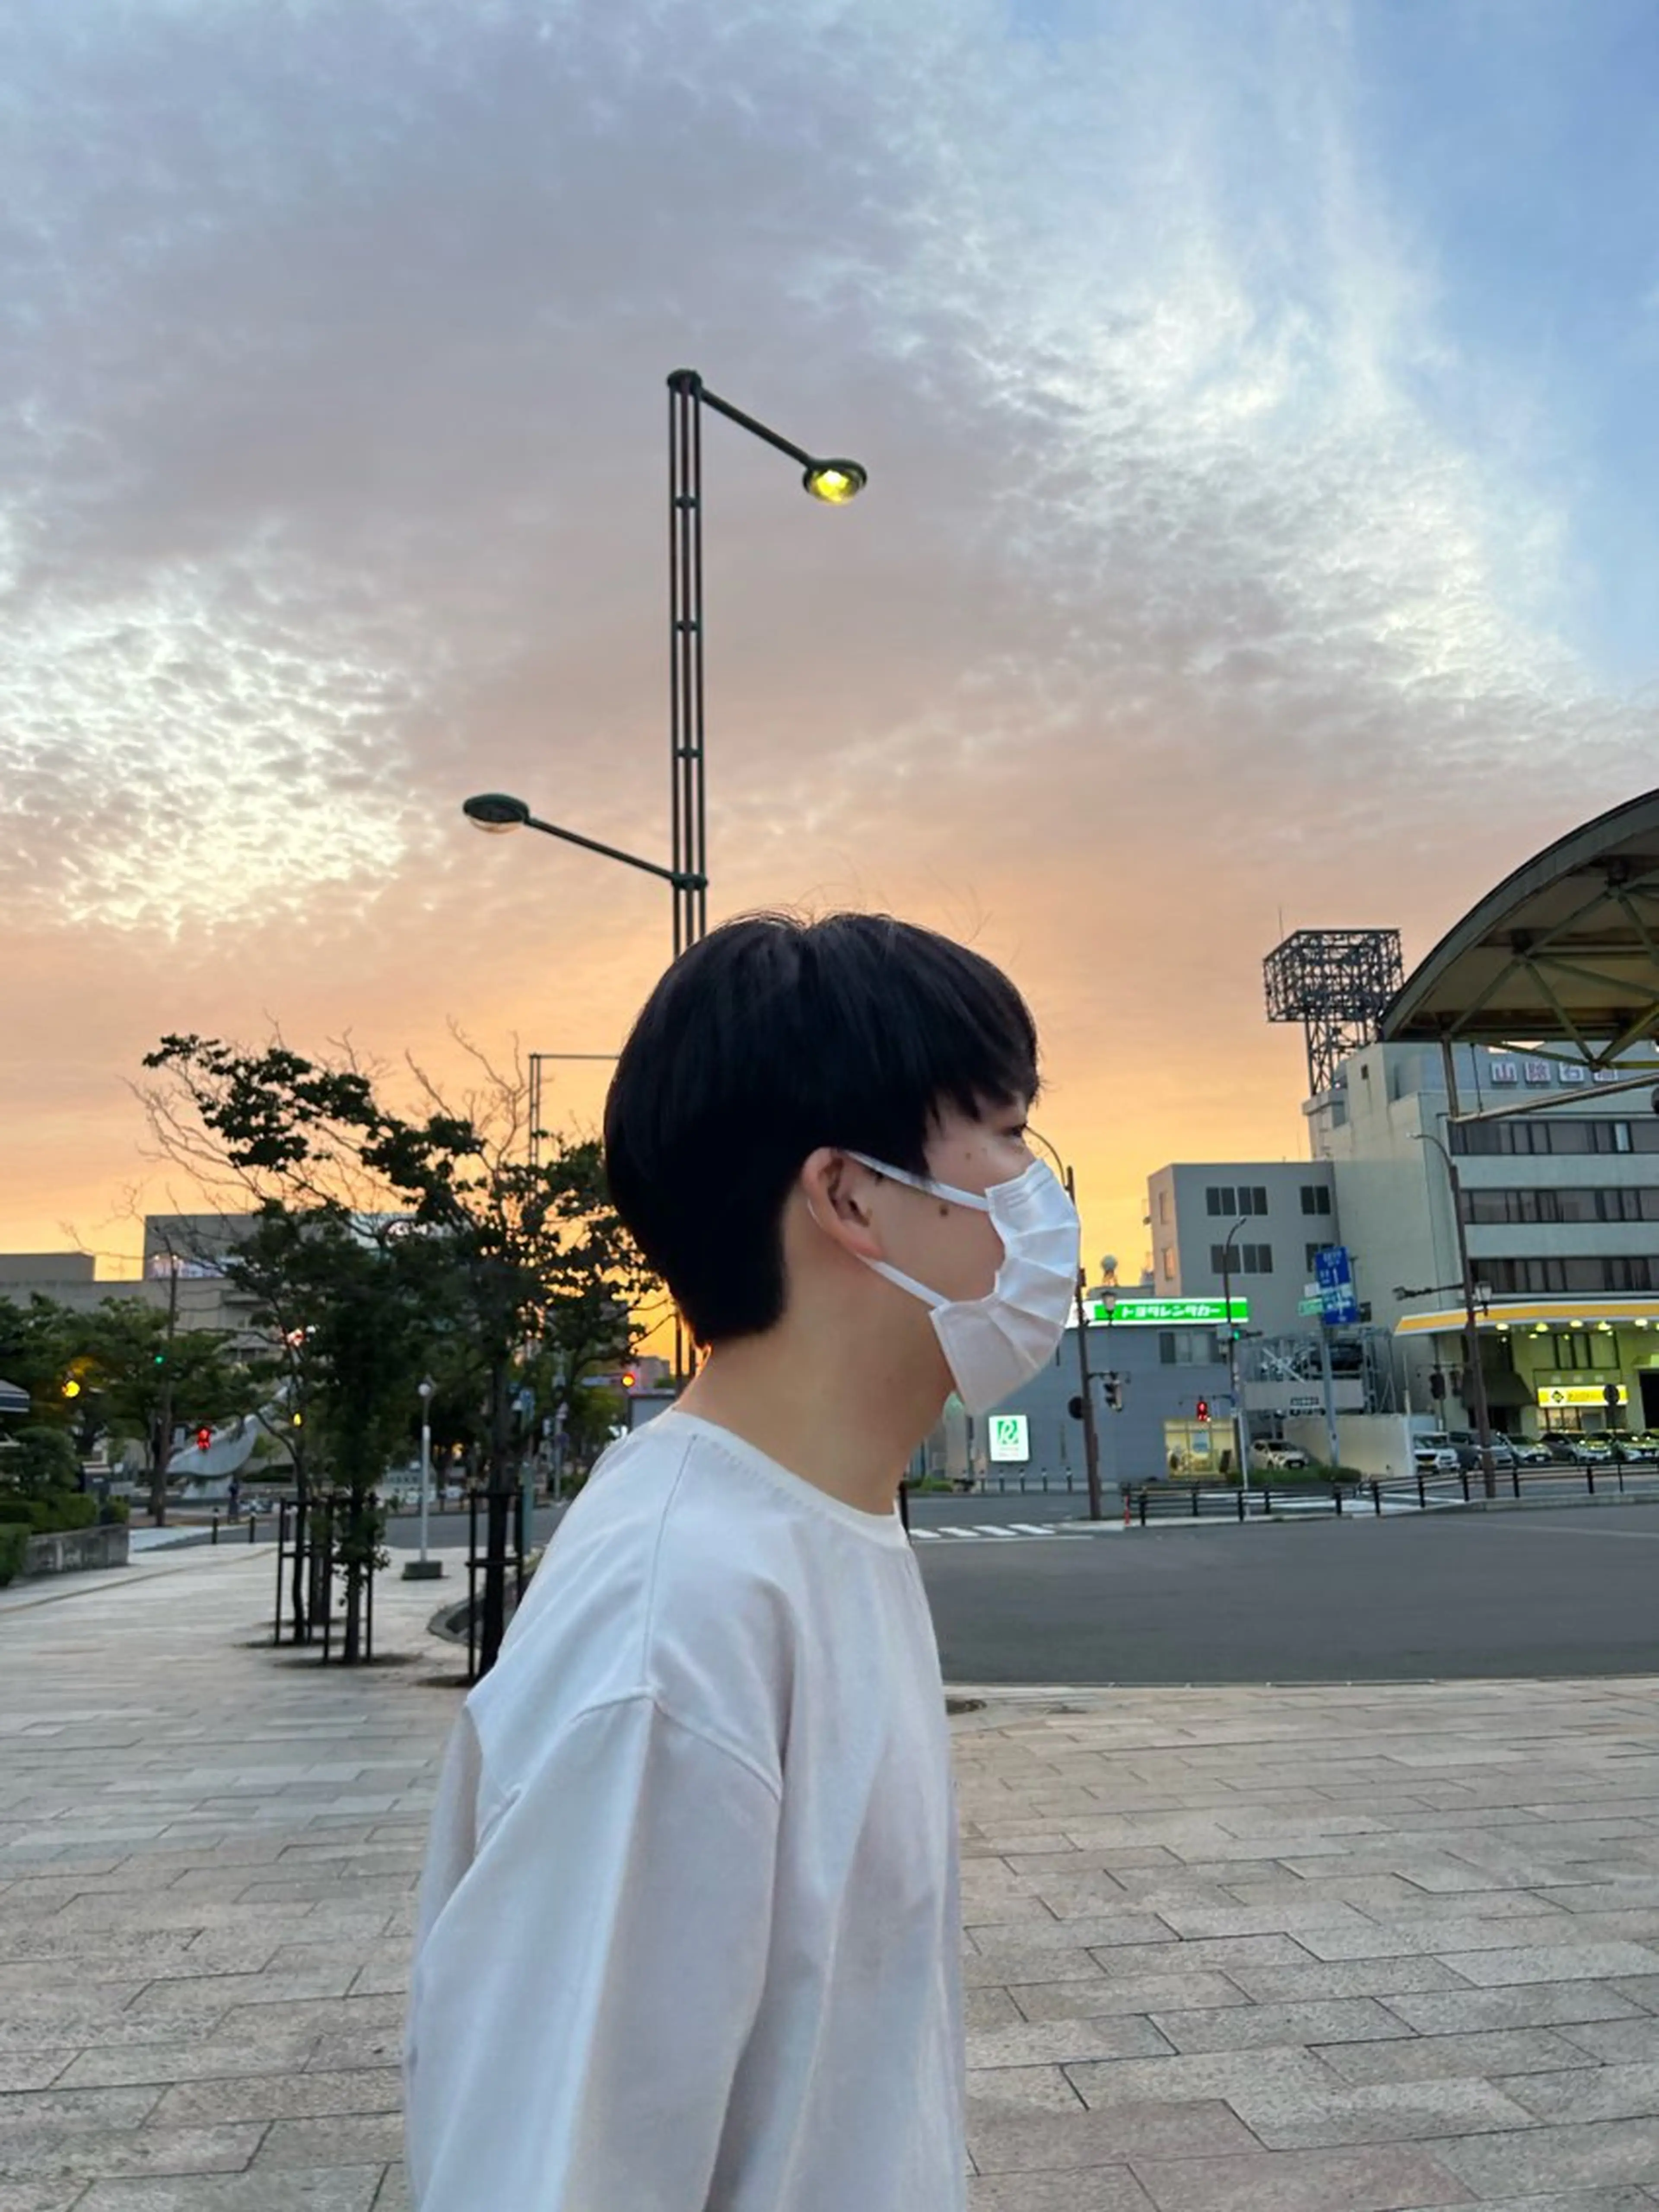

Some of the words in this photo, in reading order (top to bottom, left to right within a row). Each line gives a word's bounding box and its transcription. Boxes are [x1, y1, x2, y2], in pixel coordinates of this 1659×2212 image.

[1122, 1304, 1221, 1318] トヨタレンタカー
